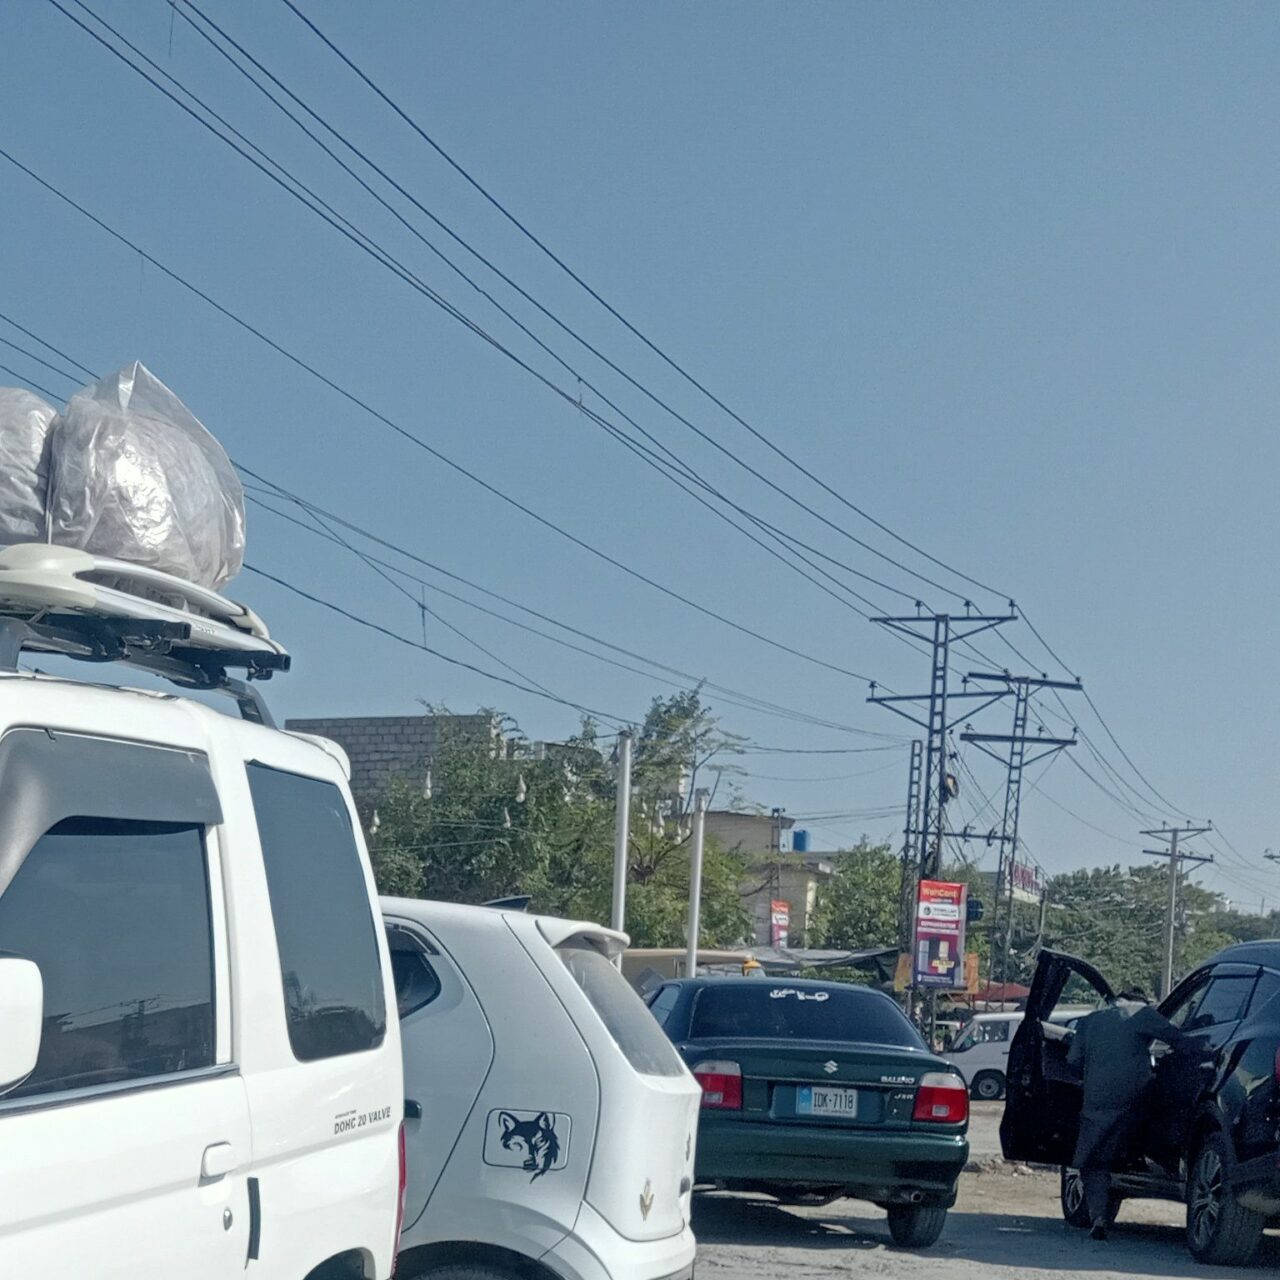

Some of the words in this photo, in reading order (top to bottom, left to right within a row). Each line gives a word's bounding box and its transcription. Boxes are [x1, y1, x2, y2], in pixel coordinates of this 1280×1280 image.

[334, 1117, 356, 1135] DOHC
[357, 1113, 367, 1127] 20
[368, 1105, 391, 1123] VALVE
